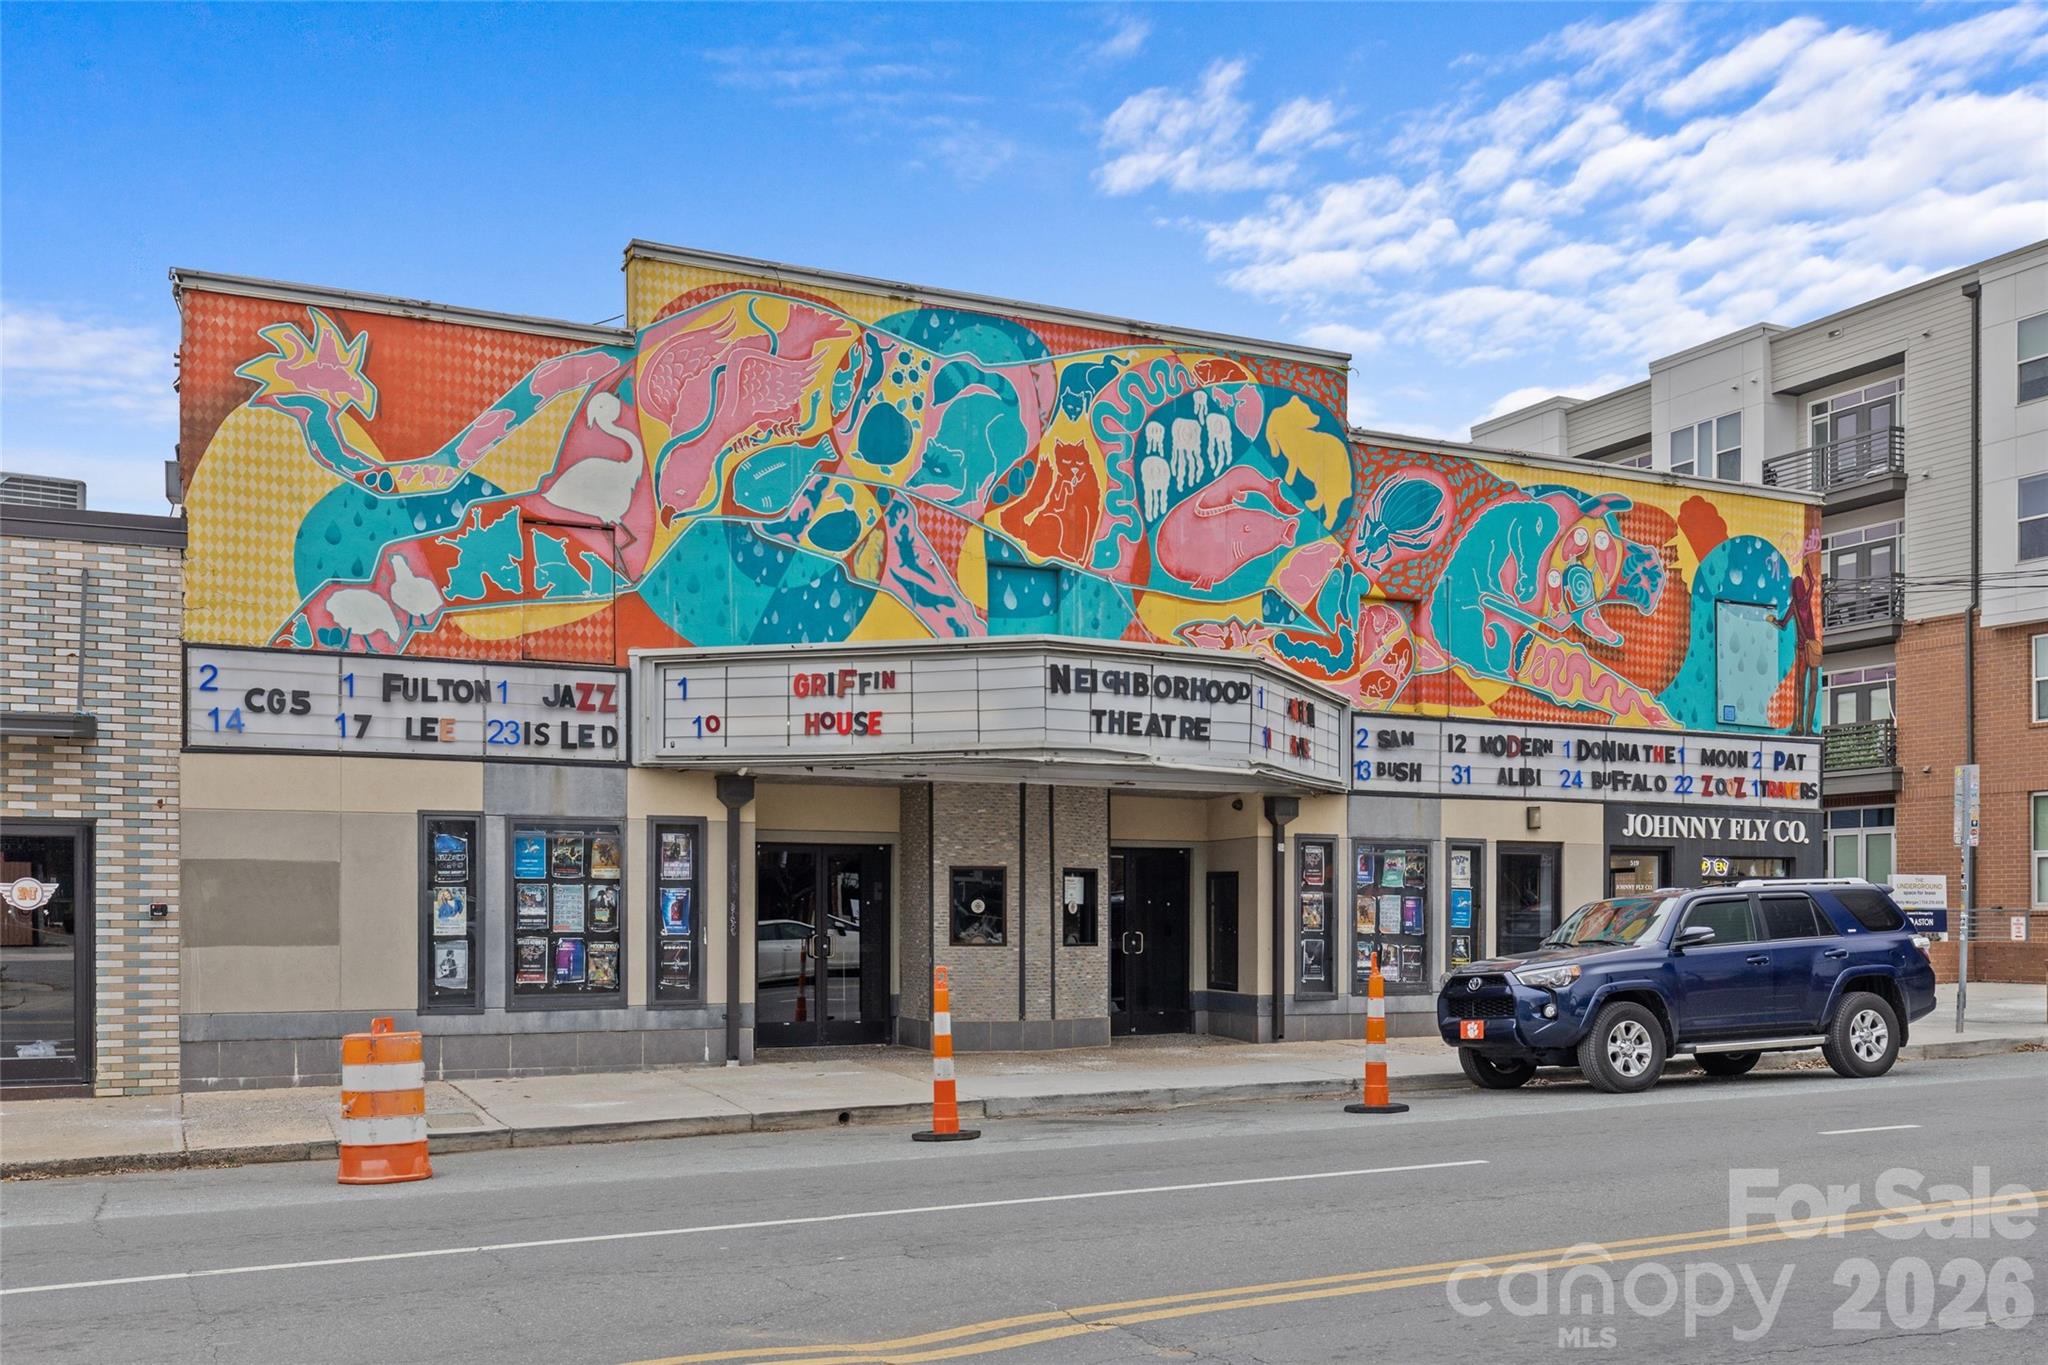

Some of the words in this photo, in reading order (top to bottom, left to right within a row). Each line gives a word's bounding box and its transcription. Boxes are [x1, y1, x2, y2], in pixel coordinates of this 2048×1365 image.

[199, 664, 219, 691] 2
[342, 672, 355, 698] 1
[382, 672, 492, 703] FULTON
[677, 677, 688, 701] 1
[793, 669, 896, 698] GRIFFIN
[1050, 664, 1250, 704] NEIGHBORHOOD
[244, 688, 311, 715] CG5
[497, 679, 508, 704] 1
[542, 682, 618, 713] JAZZ
[207, 707, 245, 733] 14
[335, 712, 373, 739] 17
[405, 717, 456, 742] LEE
[692, 714, 720, 739] 10
[805, 711, 882, 737] HOUSE
[1091, 709, 1211, 741] THEATRE
[487, 719, 521, 745] 23
[524, 722, 551, 746] IS
[561, 721, 619, 749] LED
[1356, 728, 1369, 749] 2
[1377, 730, 1415, 749] SAM
[1447, 733, 1467, 753] 12
[1480, 735, 1553, 758] MODERN
[1563, 741, 1571, 759] 1
[1577, 739, 1640, 762] DONNA
[1644, 745, 1676, 764] THE
[1677, 746, 1685, 765] 1
[1700, 749, 1748, 769] MOON
[1752, 751, 1762, 769] 2
[1773, 750, 1807, 771] PAT
[1354, 760, 1371, 781] 13
[1376, 762, 1422, 782] BUSH
[1451, 765, 1471, 785] 31
[1497, 767, 1541, 786] ALIBI
[1559, 769, 1583, 789] 24
[1591, 770, 1667, 792] BUFFALO
[1674, 775, 1693, 794] 22
[1701, 775, 1747, 799] ZOOZ
[1751, 779, 1759, 798] 1
[1759, 780, 1818, 800] TRAVERS
[1622, 813, 1726, 841] JOHNNY
[1728, 818, 1770, 842] FLY
[1773, 820, 1810, 844] CO.
